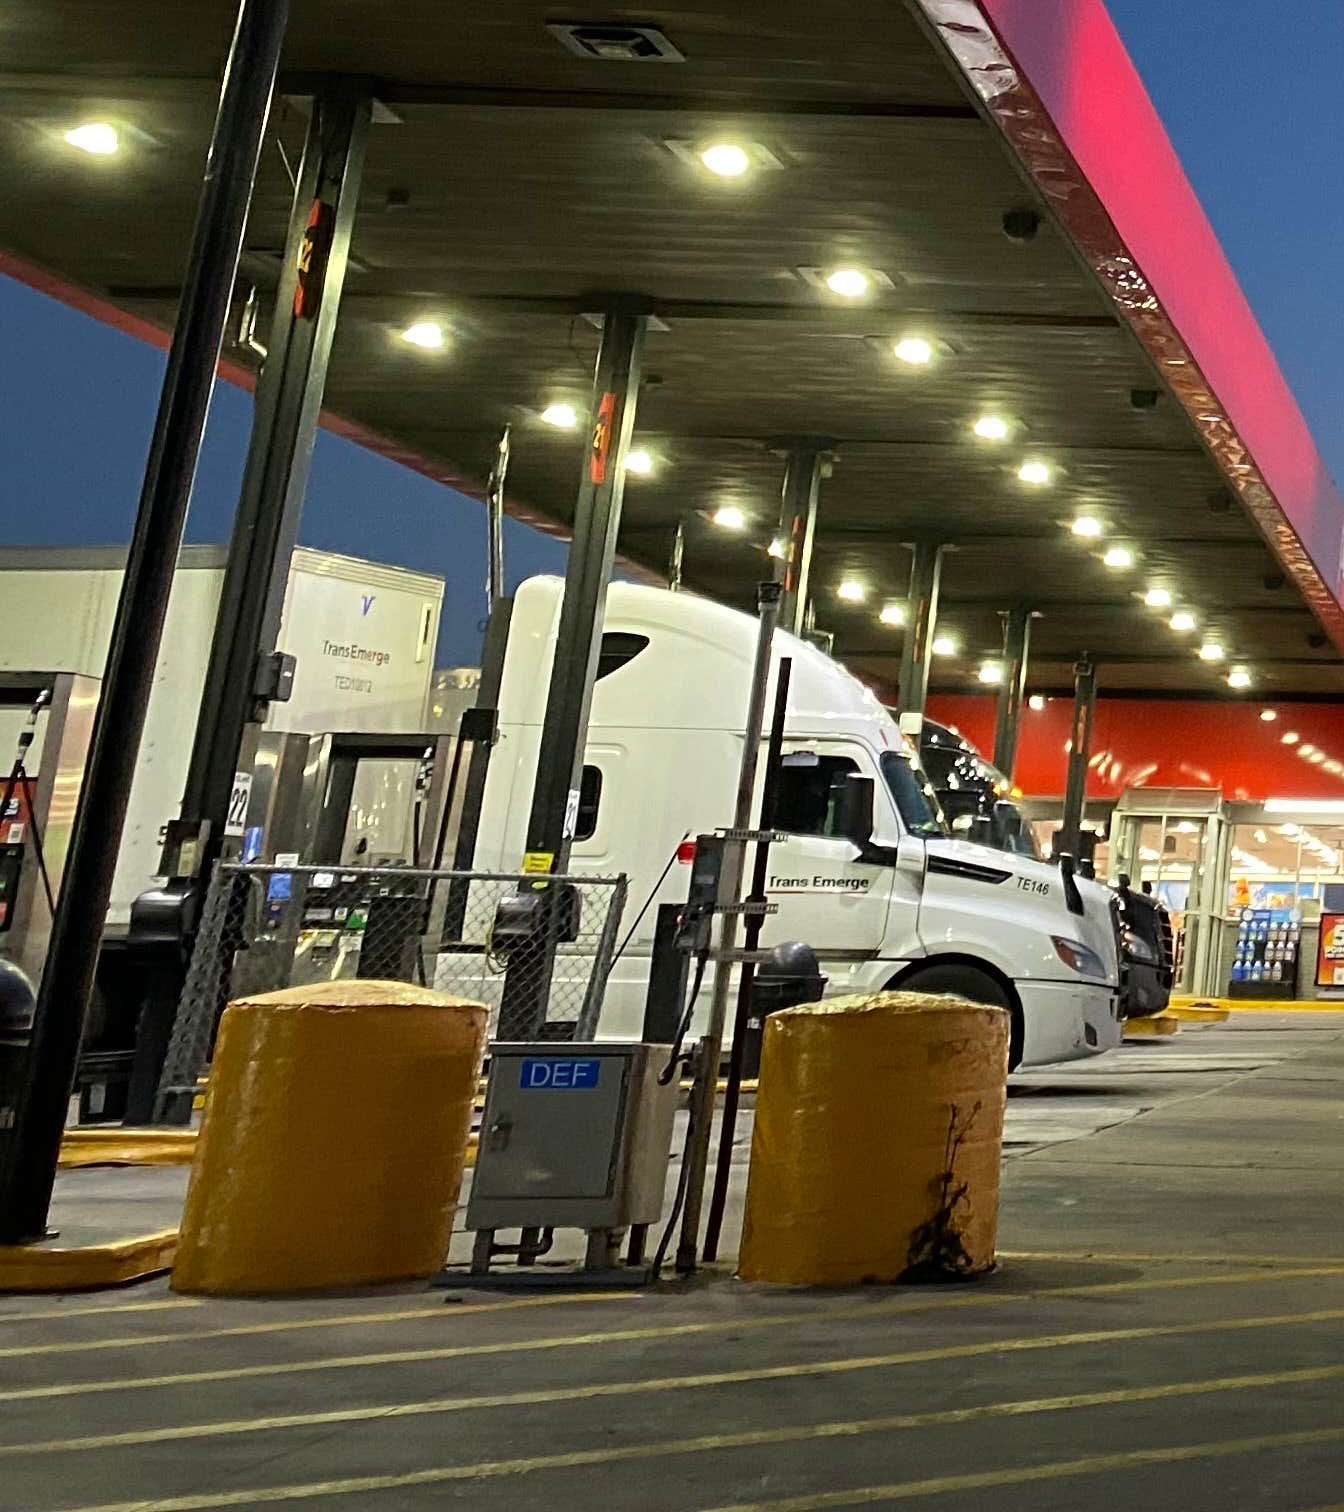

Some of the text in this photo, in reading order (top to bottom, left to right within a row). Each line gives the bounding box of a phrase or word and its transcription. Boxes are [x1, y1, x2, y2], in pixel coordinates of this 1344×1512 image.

[812, 876, 870, 890] Emerge
[1016, 876, 1050, 896] TE146
[529, 1062, 590, 1087] DEF
